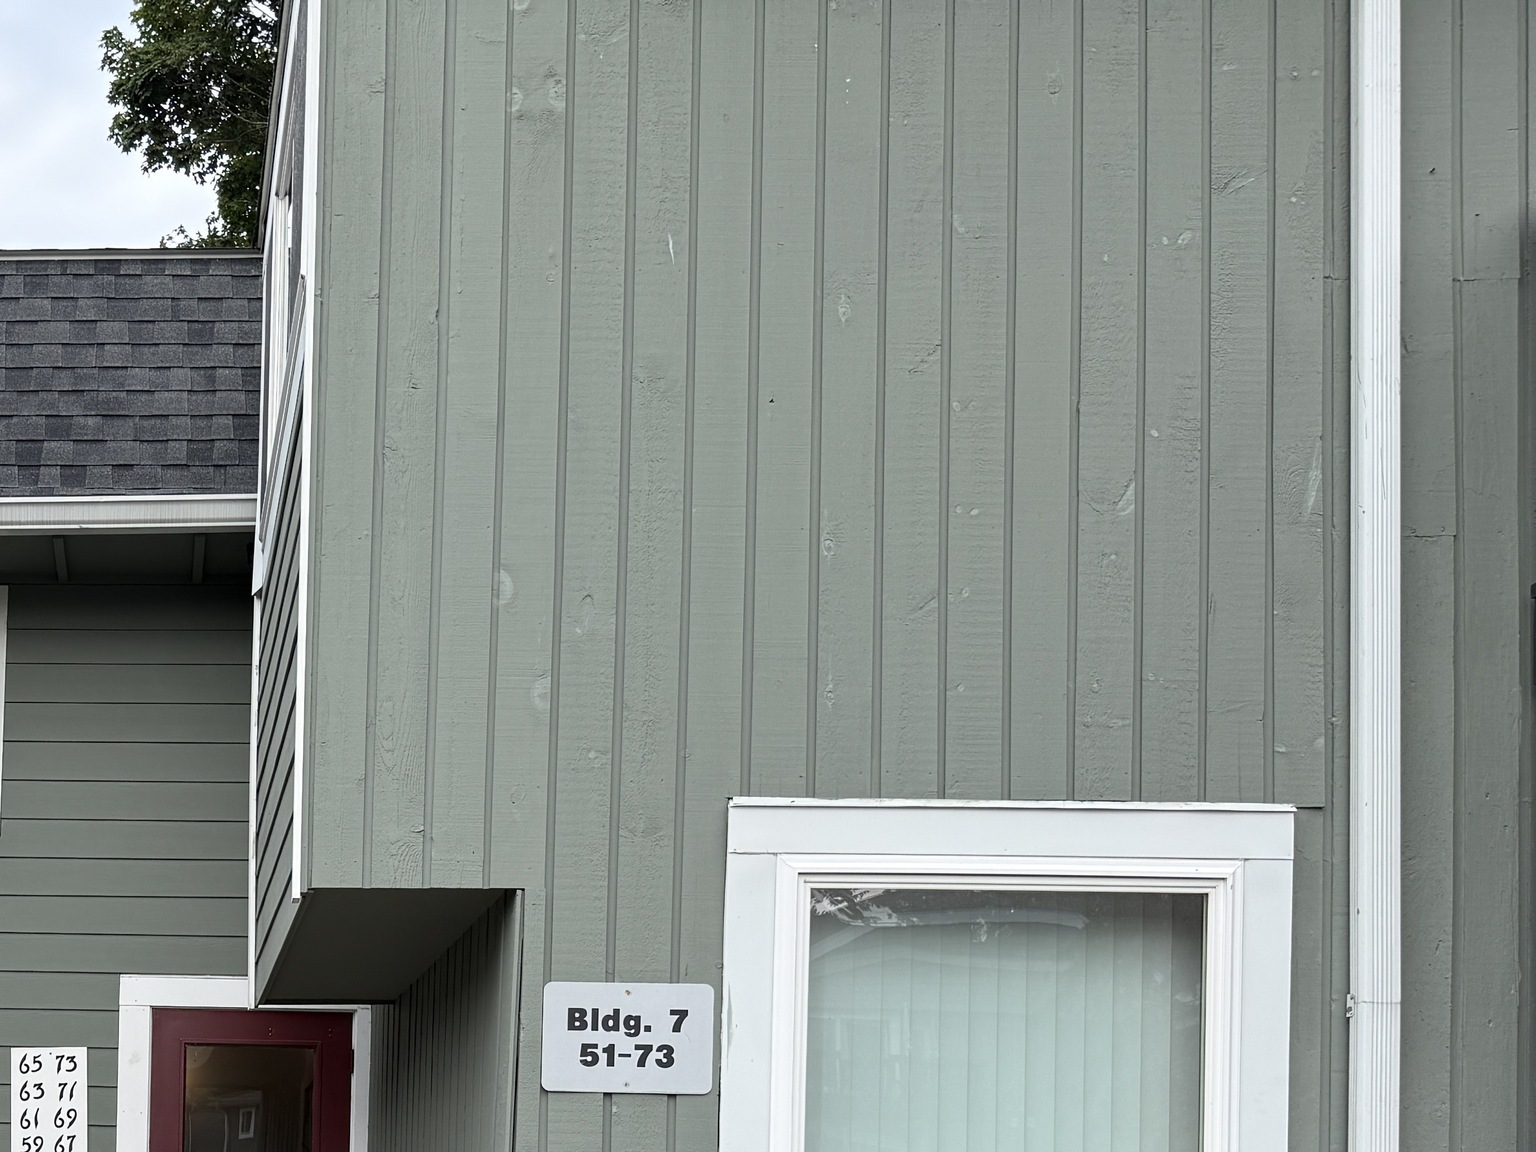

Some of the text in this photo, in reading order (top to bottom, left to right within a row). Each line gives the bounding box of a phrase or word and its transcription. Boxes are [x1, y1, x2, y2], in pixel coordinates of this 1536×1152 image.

[567, 1007, 689, 1037] Bldg. 7
[19, 1053, 77, 1075] 65 73
[579, 1043, 675, 1069] 51-73
[19, 1080, 77, 1102] 63 71
[20, 1107, 77, 1129] 61 69
